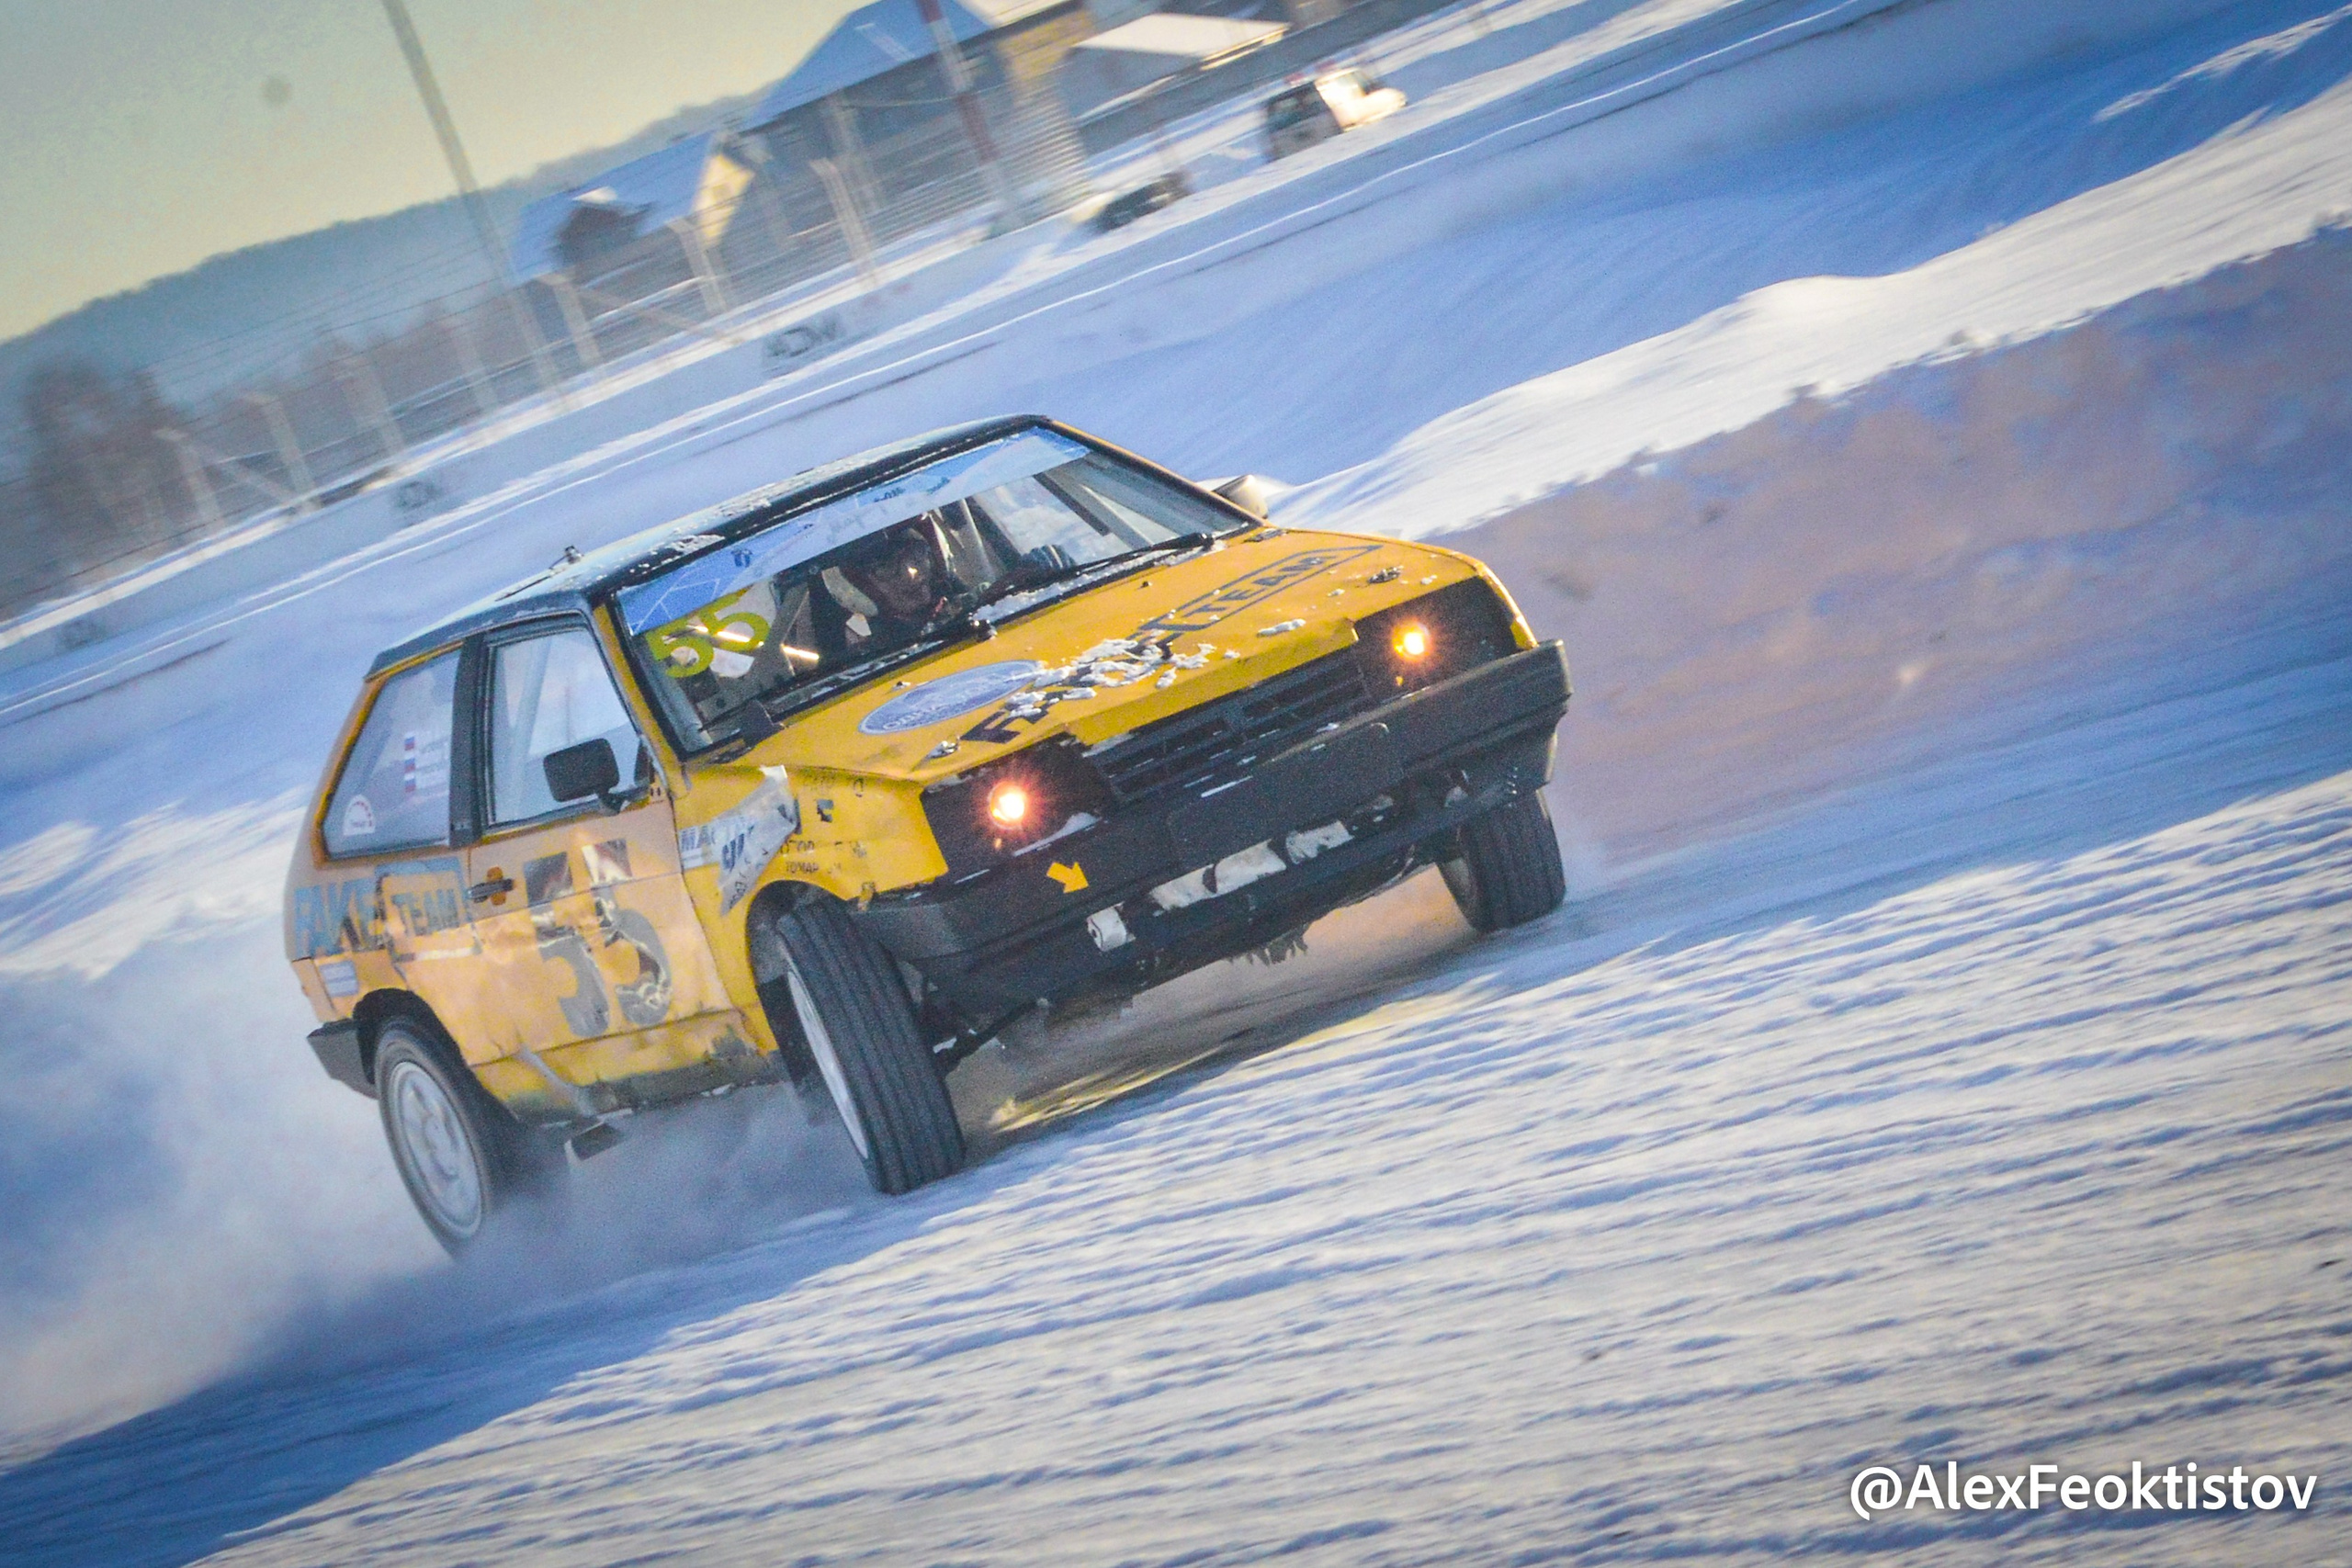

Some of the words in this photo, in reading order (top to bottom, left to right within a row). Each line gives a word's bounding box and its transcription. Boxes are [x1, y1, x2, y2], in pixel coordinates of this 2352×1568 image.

[1182, 555, 1338, 618] TEAM
[645, 584, 771, 678] 55
[391, 888, 460, 937] TEAM
